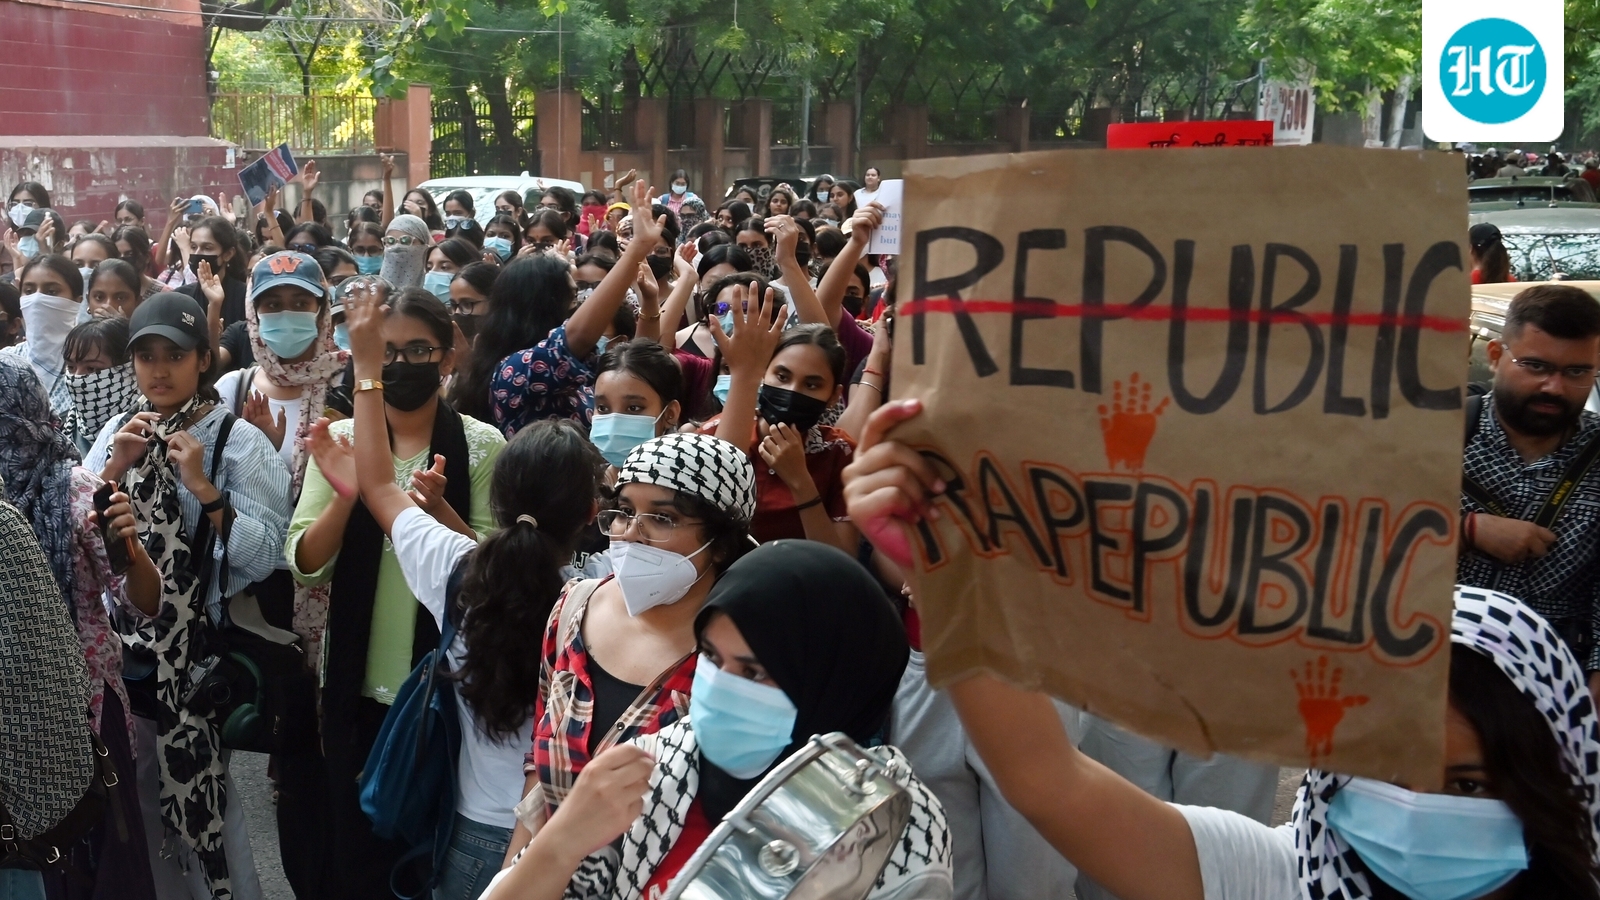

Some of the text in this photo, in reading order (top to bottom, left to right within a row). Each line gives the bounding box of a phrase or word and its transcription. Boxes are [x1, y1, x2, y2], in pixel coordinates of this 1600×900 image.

[269, 256, 303, 275] W
[911, 225, 1464, 420] REPUBLIC
[911, 449, 1450, 659] RAPEPUBLIC
